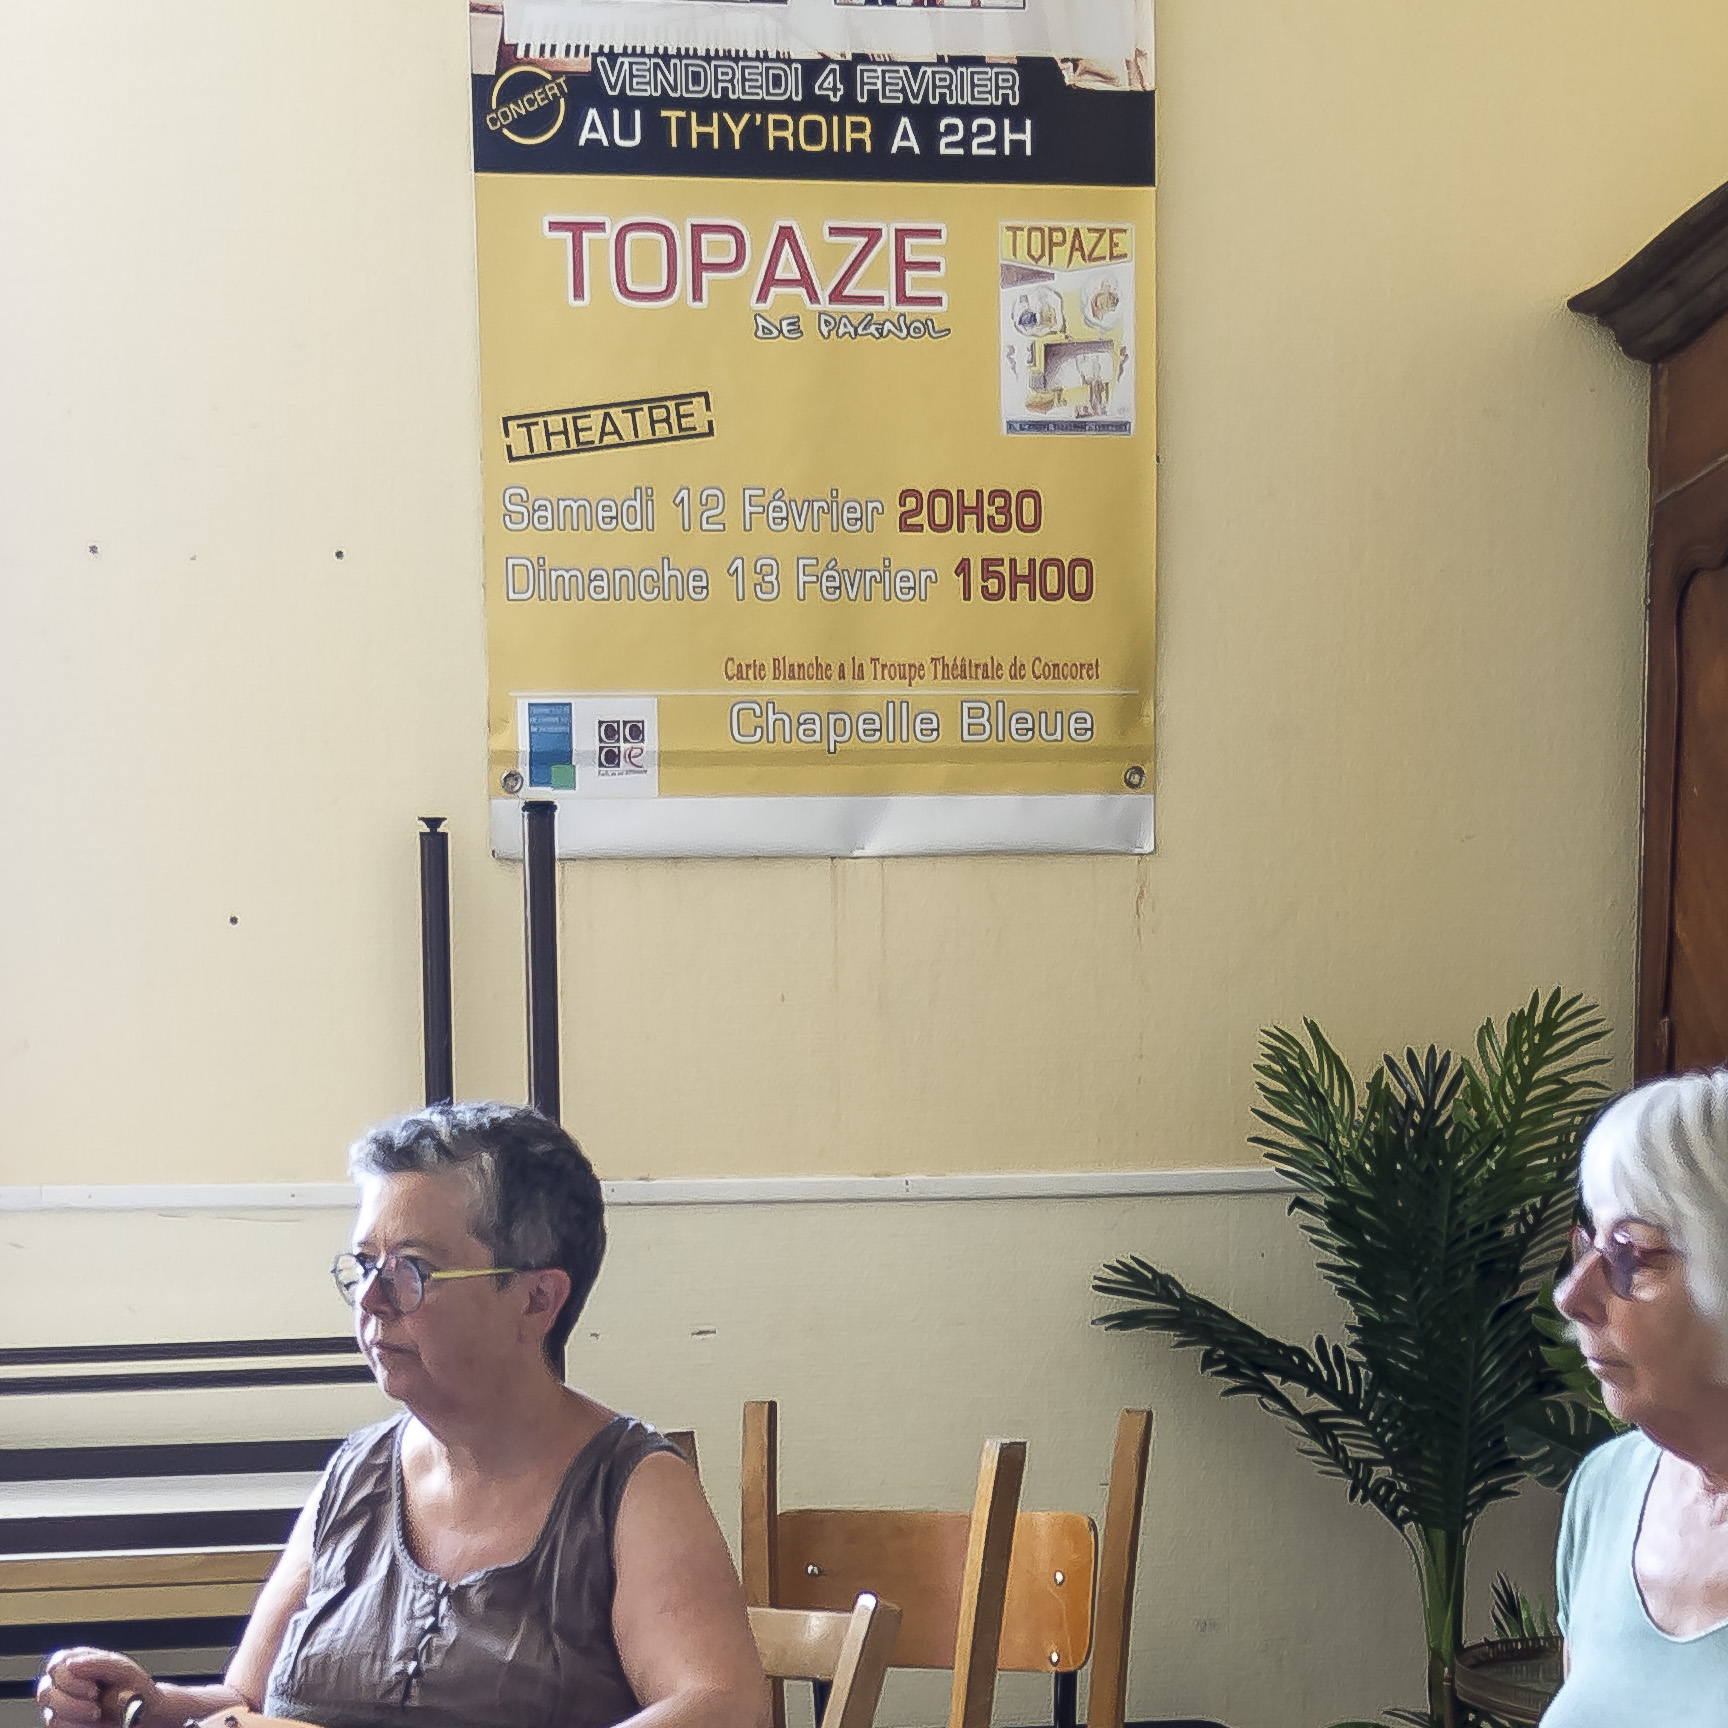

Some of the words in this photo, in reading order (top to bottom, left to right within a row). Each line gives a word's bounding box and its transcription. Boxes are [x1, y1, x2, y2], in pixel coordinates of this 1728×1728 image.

[485, 75, 570, 131] CONCERT
[595, 55, 803, 102] VENDREDI
[814, 62, 844, 103] 4
[856, 63, 1020, 106] FEVRIER
[578, 107, 642, 147] AU
[660, 109, 872, 153] THY'ROIR
[890, 116, 921, 155] A
[939, 117, 1032, 157] 22H
[544, 216, 947, 311] TOPAZE
[1004, 225, 1129, 268] TOPAZE
[754, 312, 804, 341] DE
[818, 312, 952, 341] PAGNOL
[516, 400, 698, 454] THEATRE
[502, 486, 655, 532] Samedi
[672, 486, 726, 532] 12
[741, 487, 885, 533] Février
[897, 488, 1043, 533] 20H30
[505, 556, 710, 602] Dimanche
[726, 556, 781, 602] 13
[796, 557, 938, 602] Février
[954, 557, 1095, 602] 15H00
[723, 655, 766, 682] Carte
[772, 655, 833, 682] Blanche
[851, 656, 865, 681] la
[870, 656, 926, 687] Troupe
[930, 656, 1004, 682] Théâtrale
[1008, 656, 1027, 681] de
[1030, 656, 1101, 682] Concoret
[729, 699, 940, 755] Chapelle
[959, 699, 1095, 743] Bleue
